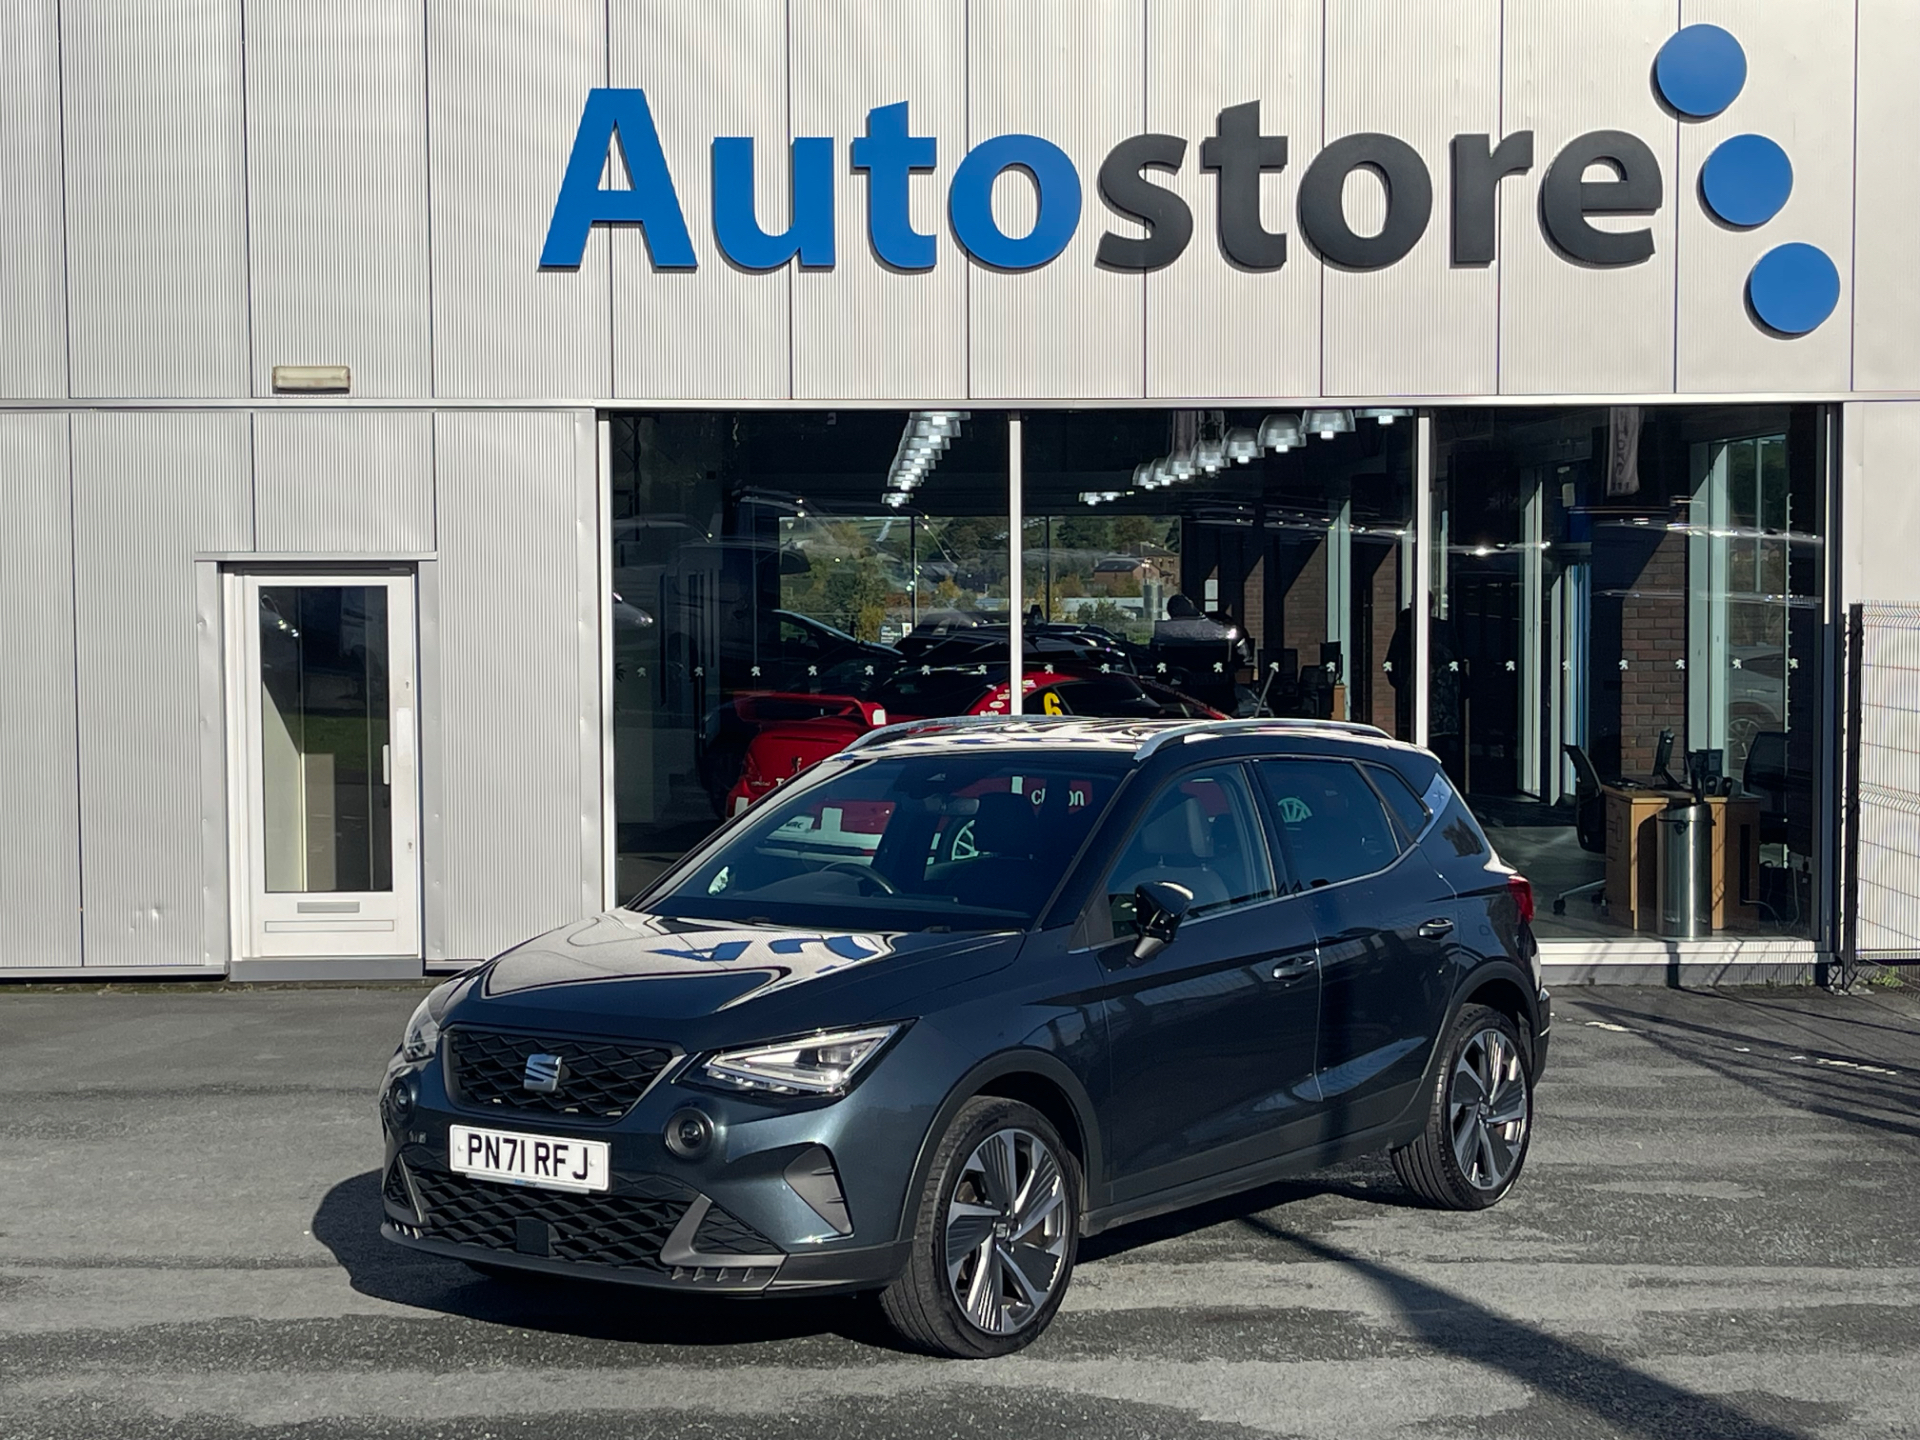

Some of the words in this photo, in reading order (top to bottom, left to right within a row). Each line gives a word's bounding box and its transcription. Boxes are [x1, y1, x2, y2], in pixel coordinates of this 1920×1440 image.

[539, 87, 1664, 273] Autostore
[1043, 692, 1064, 716] 6
[467, 1132, 526, 1173] PN71
[534, 1141, 588, 1180] RFJ
